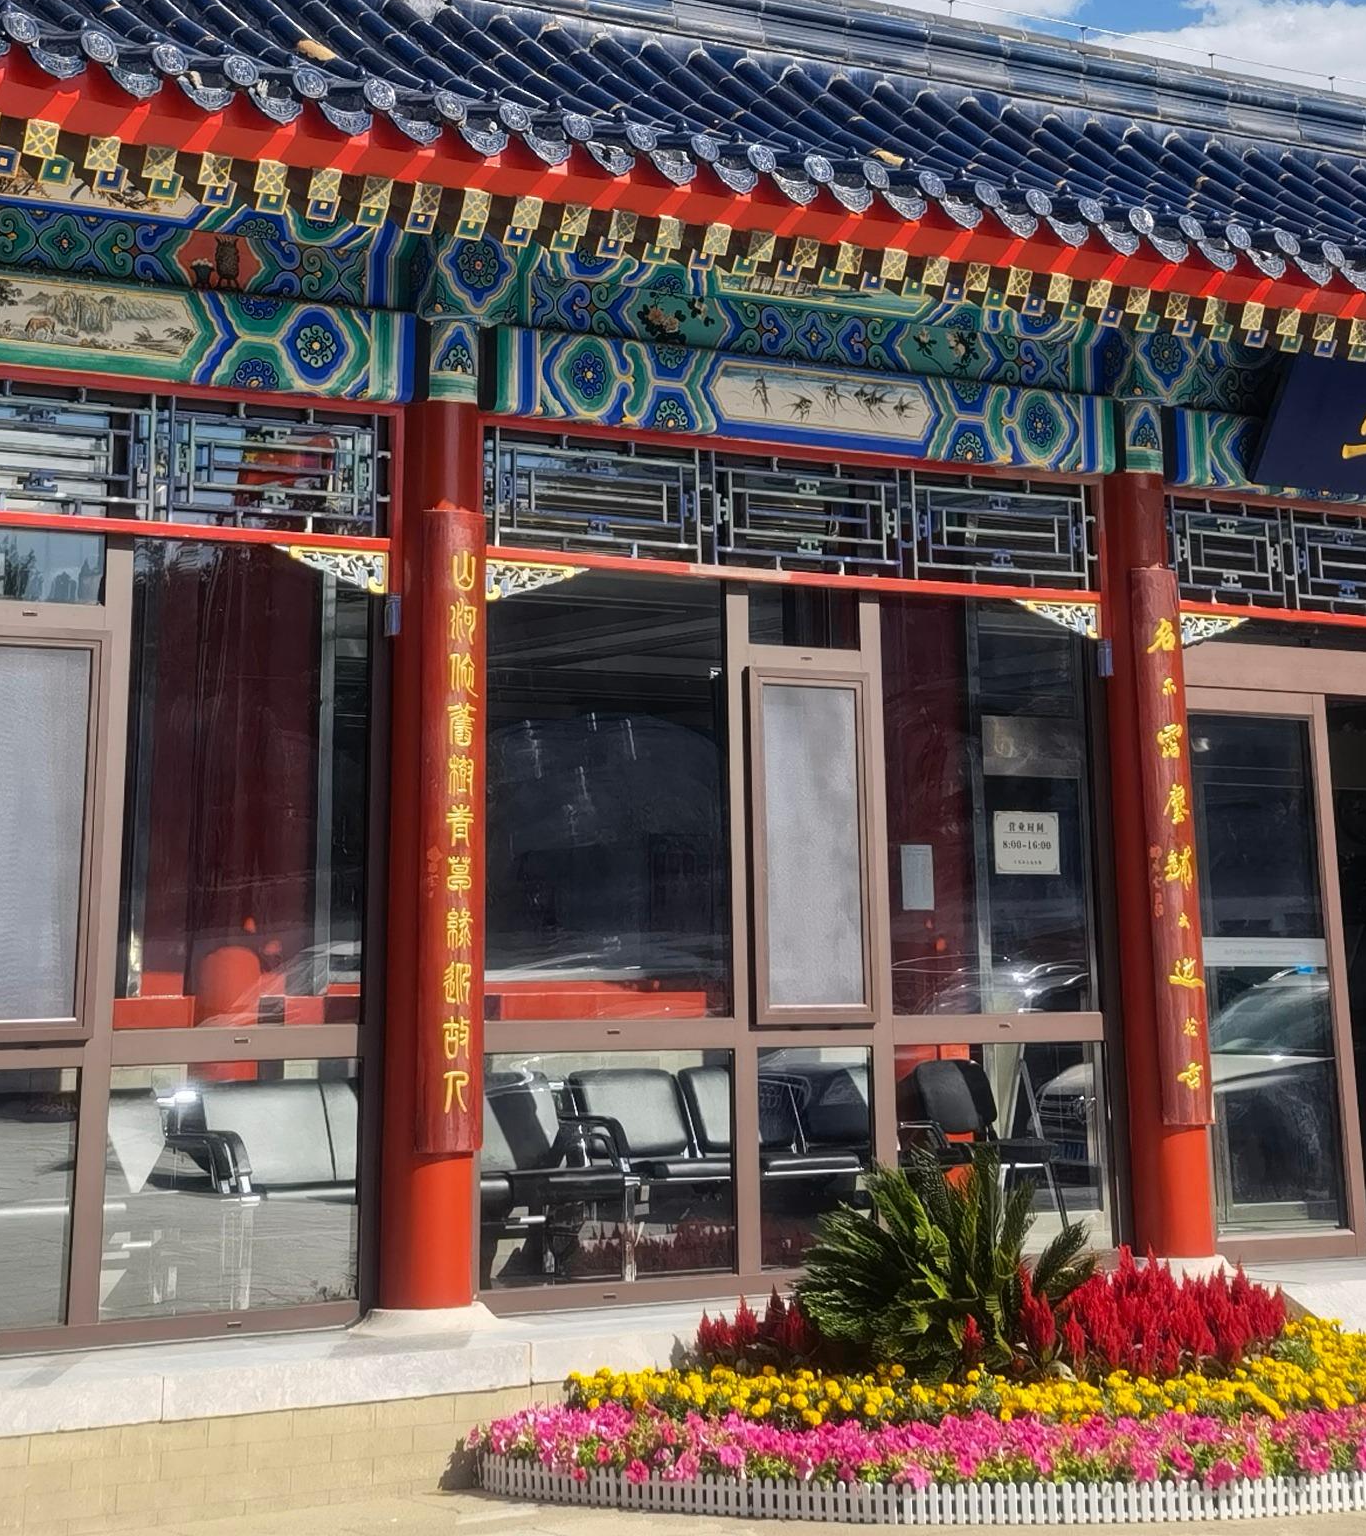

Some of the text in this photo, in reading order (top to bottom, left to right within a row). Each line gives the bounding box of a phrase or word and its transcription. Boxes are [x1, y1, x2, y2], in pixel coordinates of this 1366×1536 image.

[1009, 822, 1044, 832] 营业时间
[1003, 840, 1051, 850] 8:00-16:00
